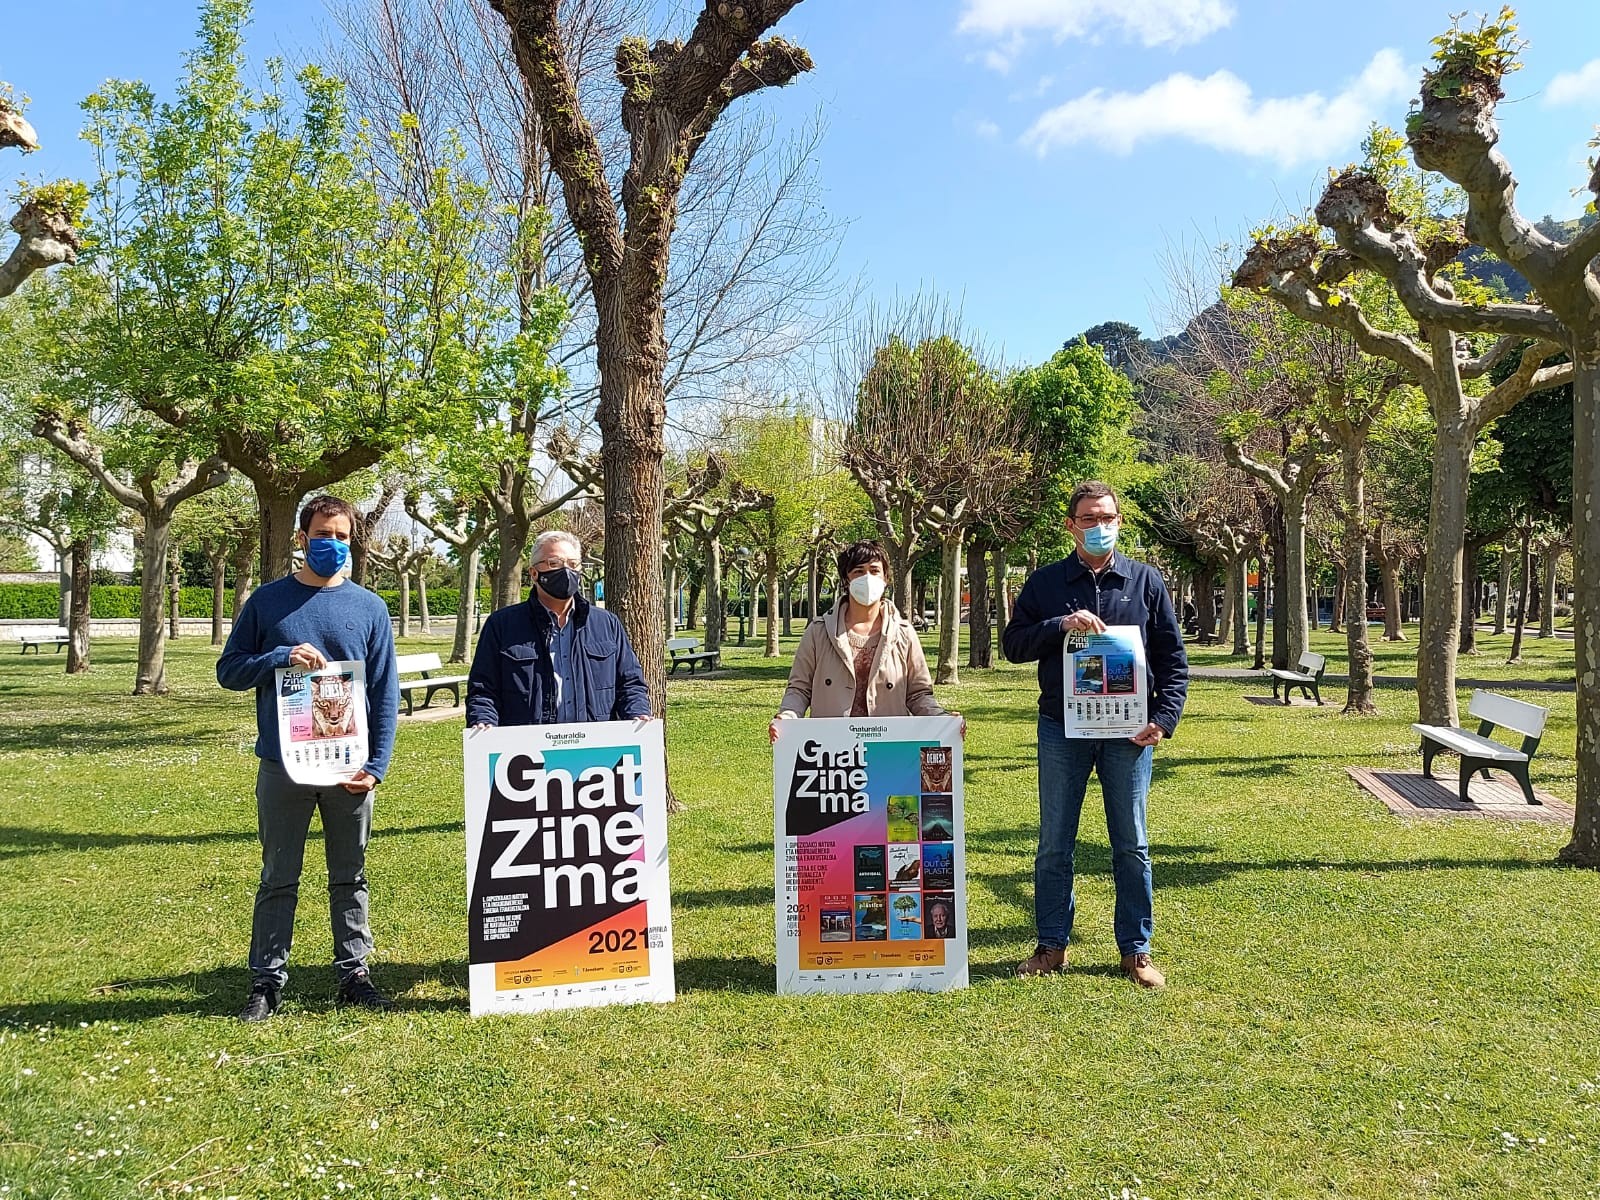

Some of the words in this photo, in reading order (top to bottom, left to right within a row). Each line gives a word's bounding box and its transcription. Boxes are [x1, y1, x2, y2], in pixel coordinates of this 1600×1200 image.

[545, 731, 586, 740] Gnaturaldia
[849, 724, 888, 733] Gnaturaldia
[799, 738, 868, 768] Gnat
[494, 749, 644, 812] Gnat
[796, 769, 868, 798] Zine
[820, 792, 870, 813] ma
[490, 811, 645, 880] Zine
[543, 859, 648, 909] ma
[786, 904, 811, 914] 2021
[588, 927, 649, 954] 2021
